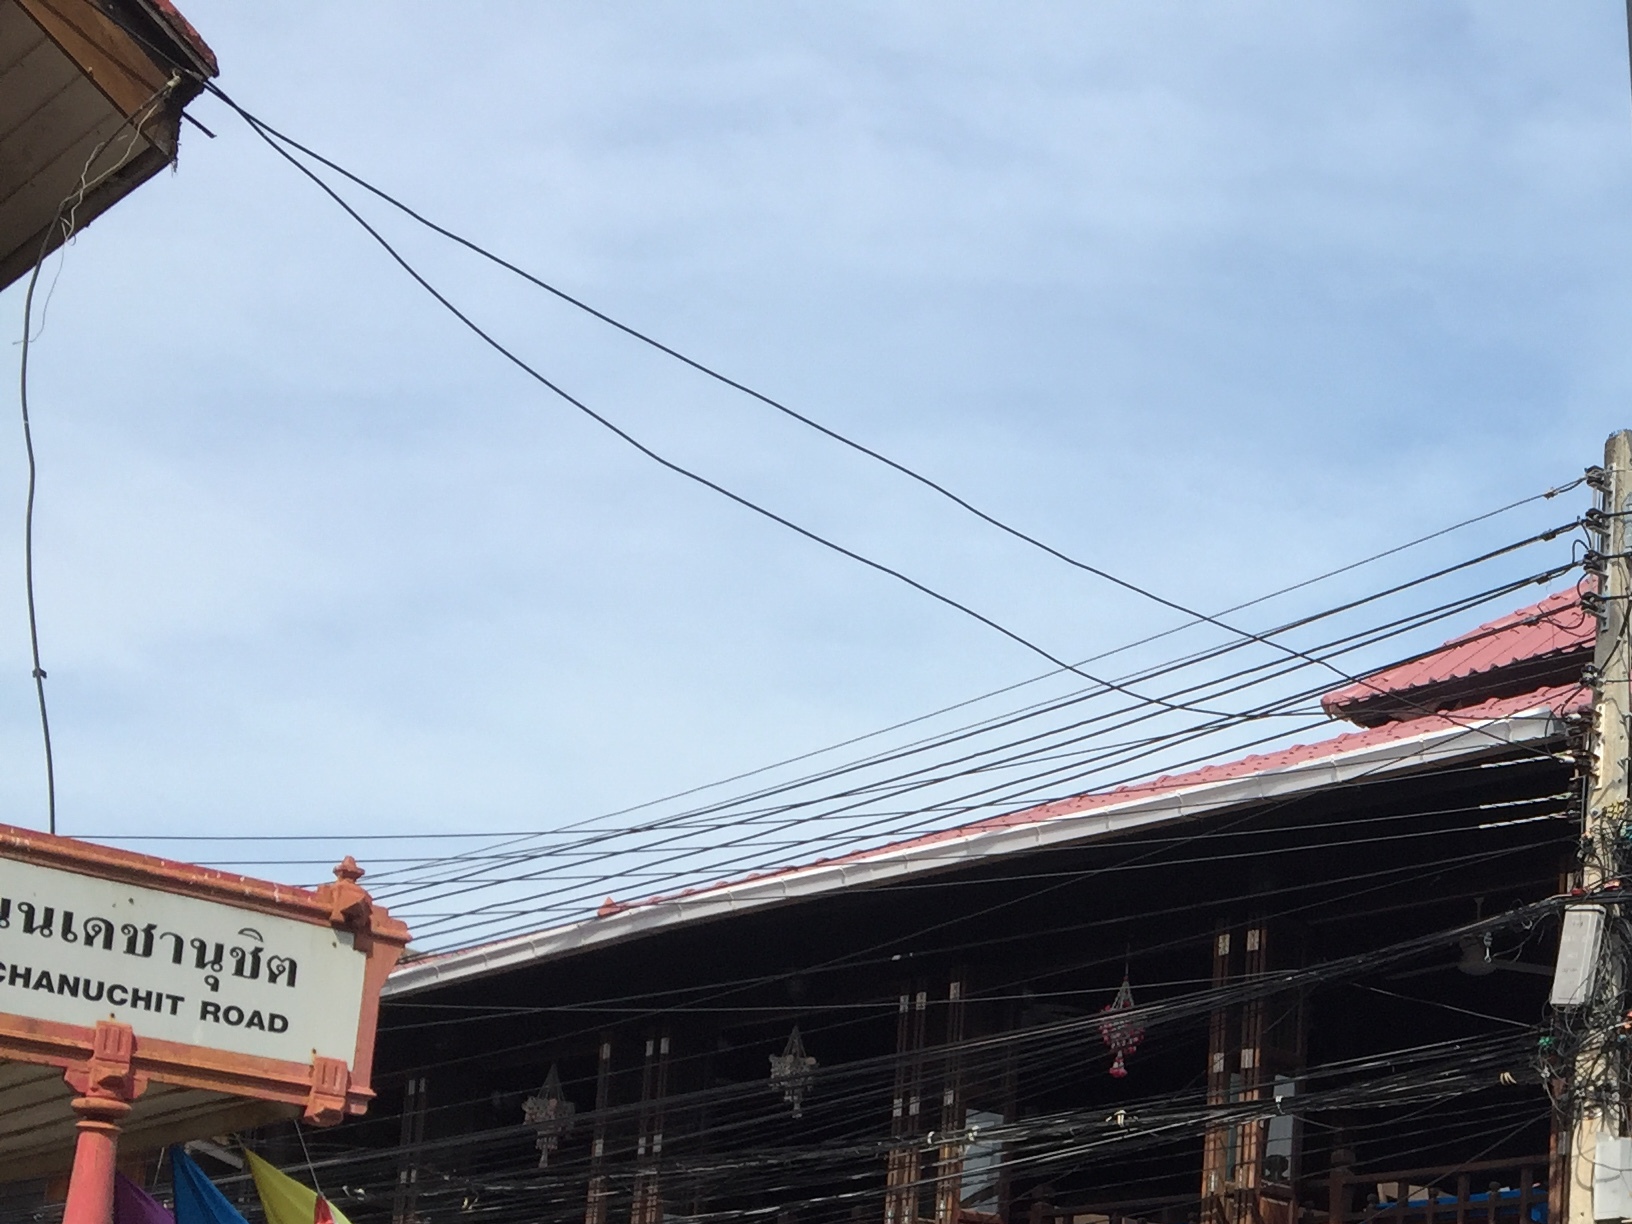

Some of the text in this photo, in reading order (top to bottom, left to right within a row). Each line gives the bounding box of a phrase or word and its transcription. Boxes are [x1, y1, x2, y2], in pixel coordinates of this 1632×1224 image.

[0, 898, 298, 992] นเดชานุชิต
[0, 960, 290, 1034] HANUCHIT ROAD
